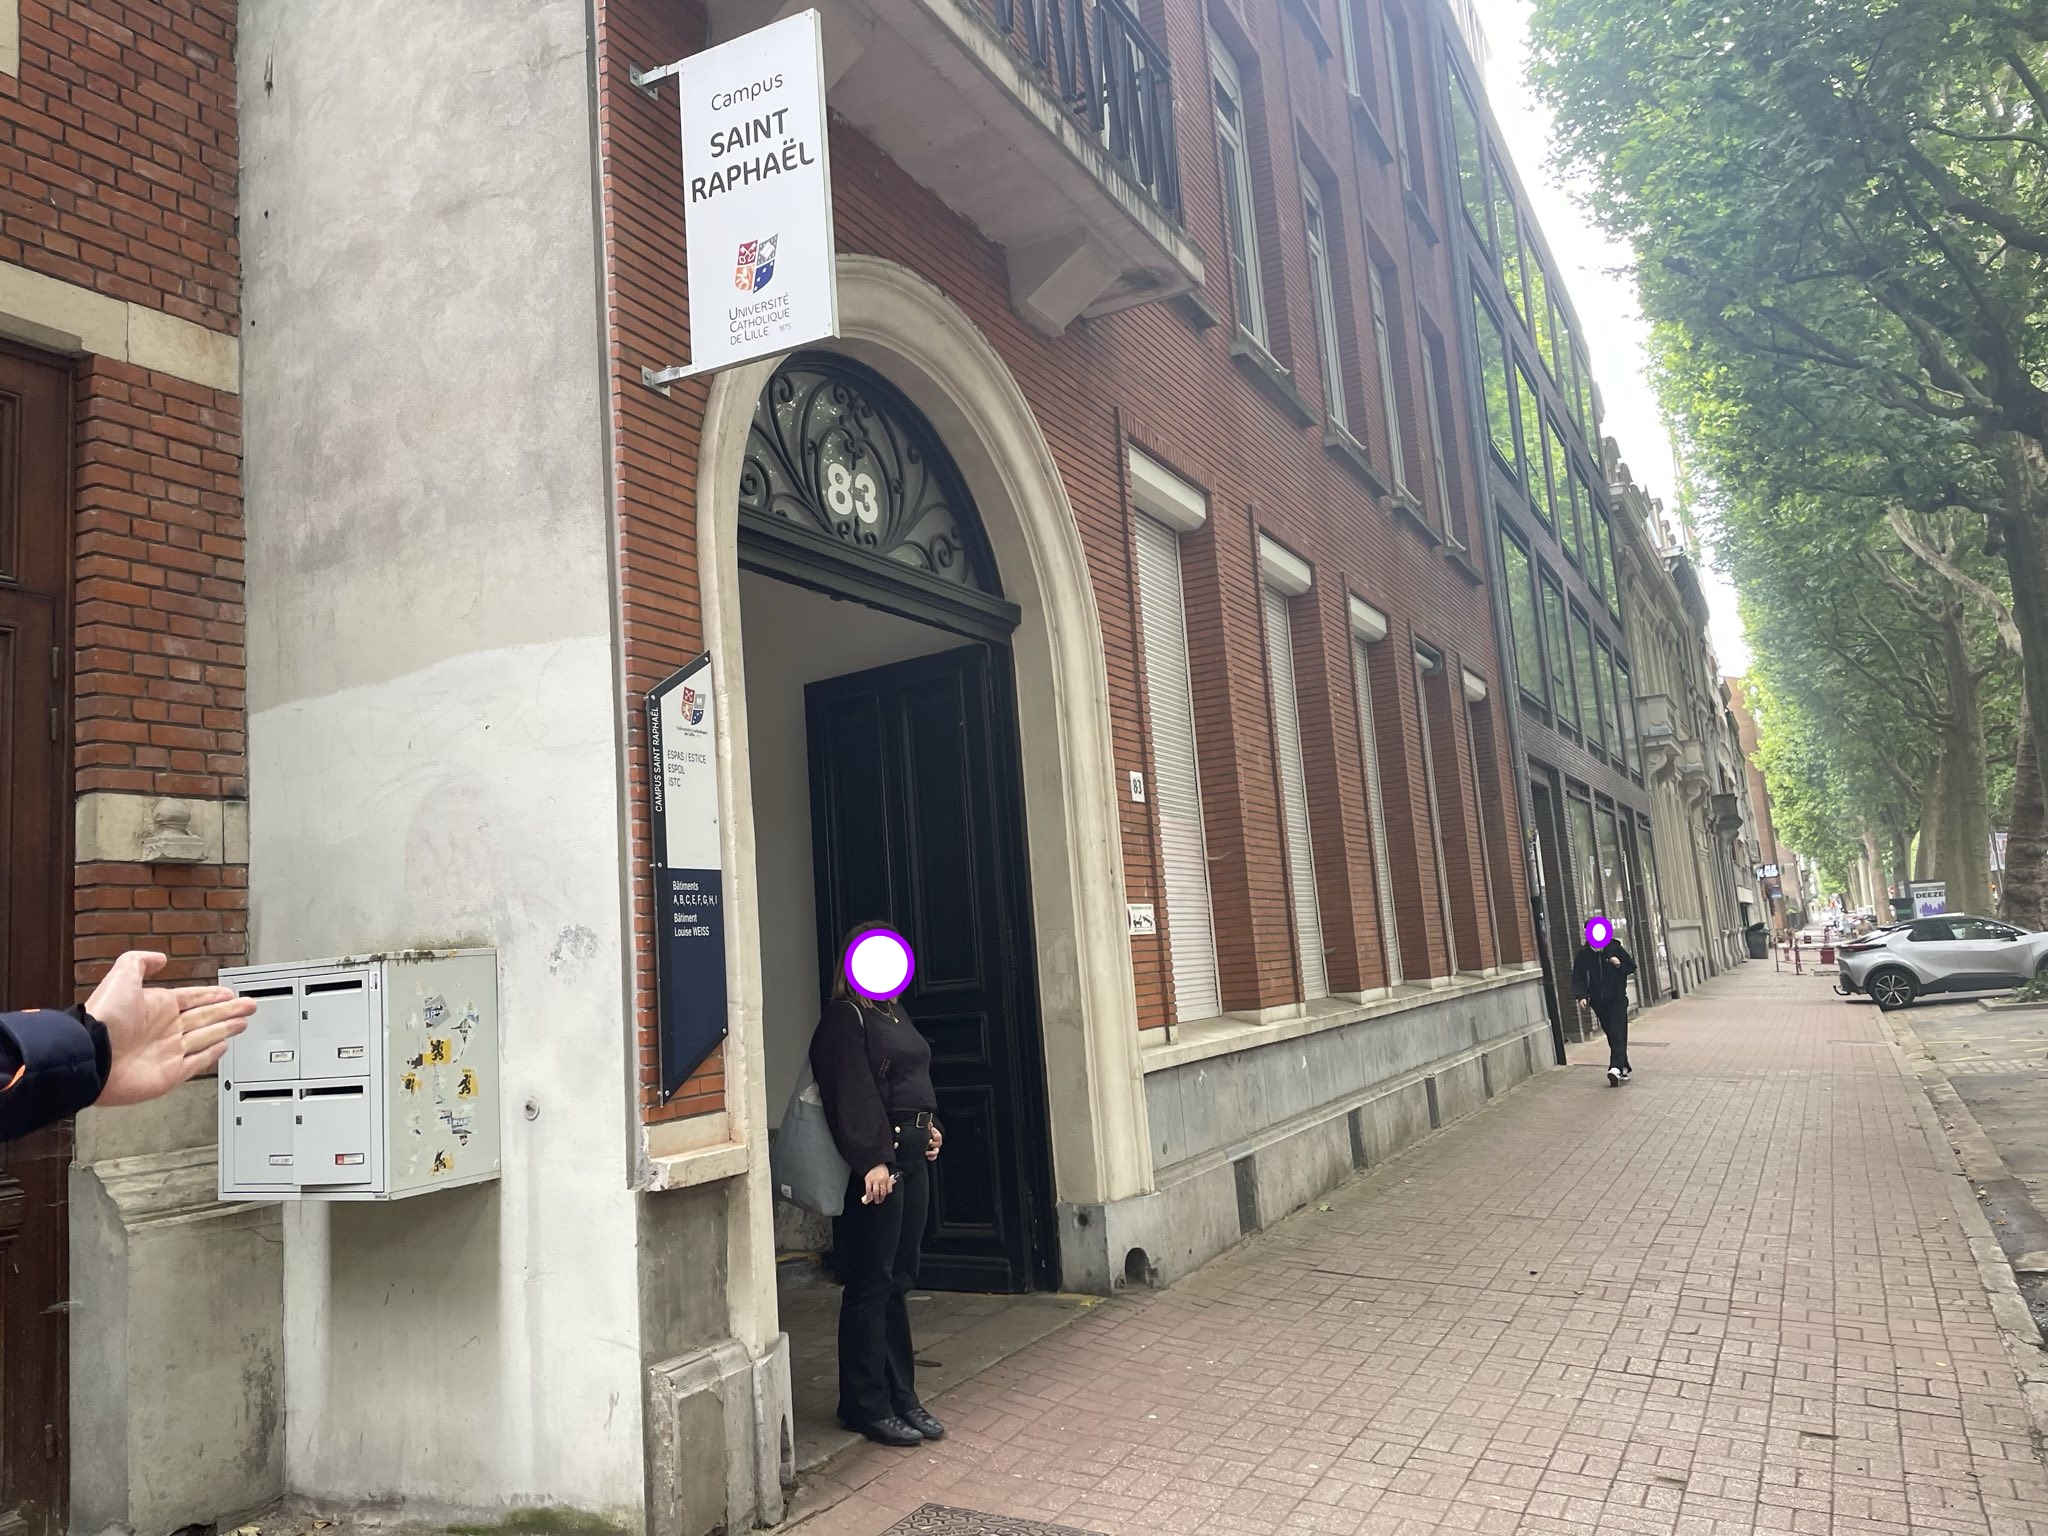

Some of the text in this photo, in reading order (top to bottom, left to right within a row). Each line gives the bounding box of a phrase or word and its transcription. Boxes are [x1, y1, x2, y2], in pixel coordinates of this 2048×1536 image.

[711, 74, 783, 111] Campus
[710, 107, 789, 158] SAINT
[692, 138, 815, 203] RAPHAËL
[729, 292, 789, 321] UNIVERSITÉ
[730, 307, 791, 333] CATHOLIQUE
[730, 334, 742, 346] DE
[744, 326, 769, 341] LILLE
[828, 463, 878, 524] 83
[650, 707, 663, 812] CAMPUS SAINT RAPHAËL
[667, 750, 684, 761] ESPAS
[688, 753, 706, 764] ESTICE
[668, 763, 685, 775] ESPOL
[669, 777, 681, 787] ISTC
[1133, 779, 1142, 794] 83
[672, 880, 699, 891] Bâtiments
[674, 912, 698, 923] Bâtiment
[675, 926, 710, 937] Louise WEISS
